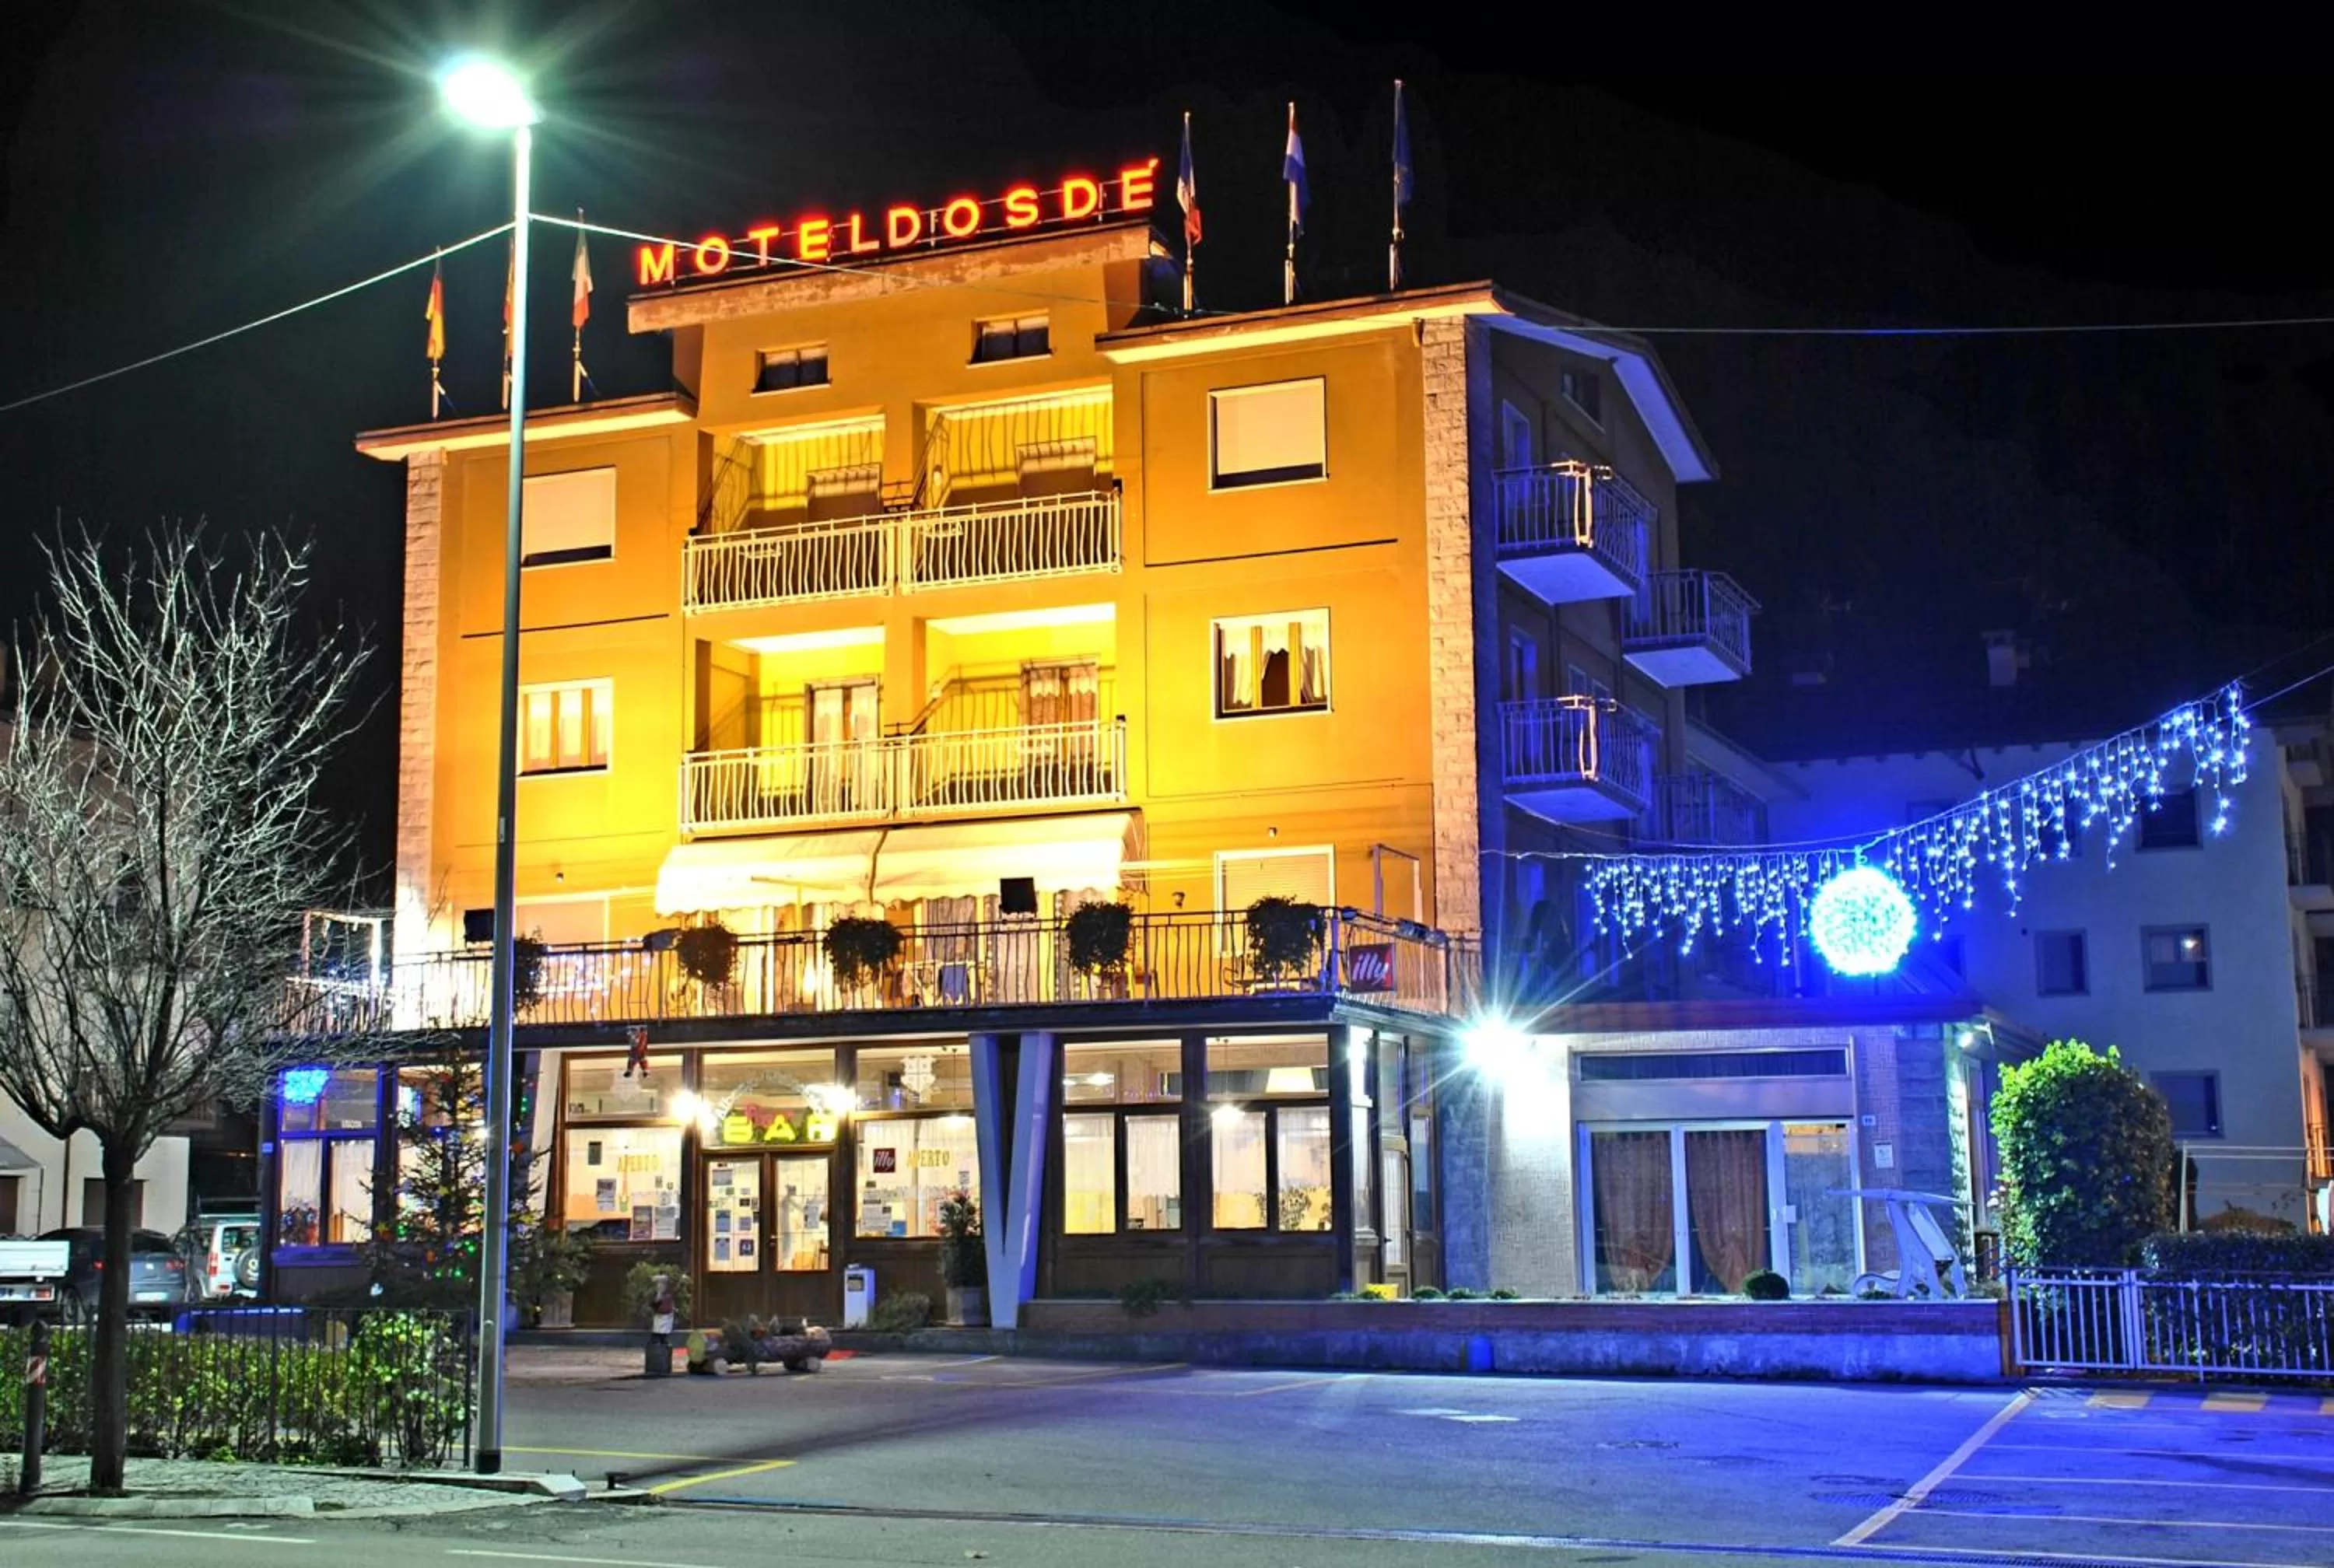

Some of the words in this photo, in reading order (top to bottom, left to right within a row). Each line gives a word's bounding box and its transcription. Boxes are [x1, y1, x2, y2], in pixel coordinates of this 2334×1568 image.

[1352, 952, 1389, 986] illy
[723, 1114, 839, 1143] BAR
[874, 1151, 895, 1171] illy
